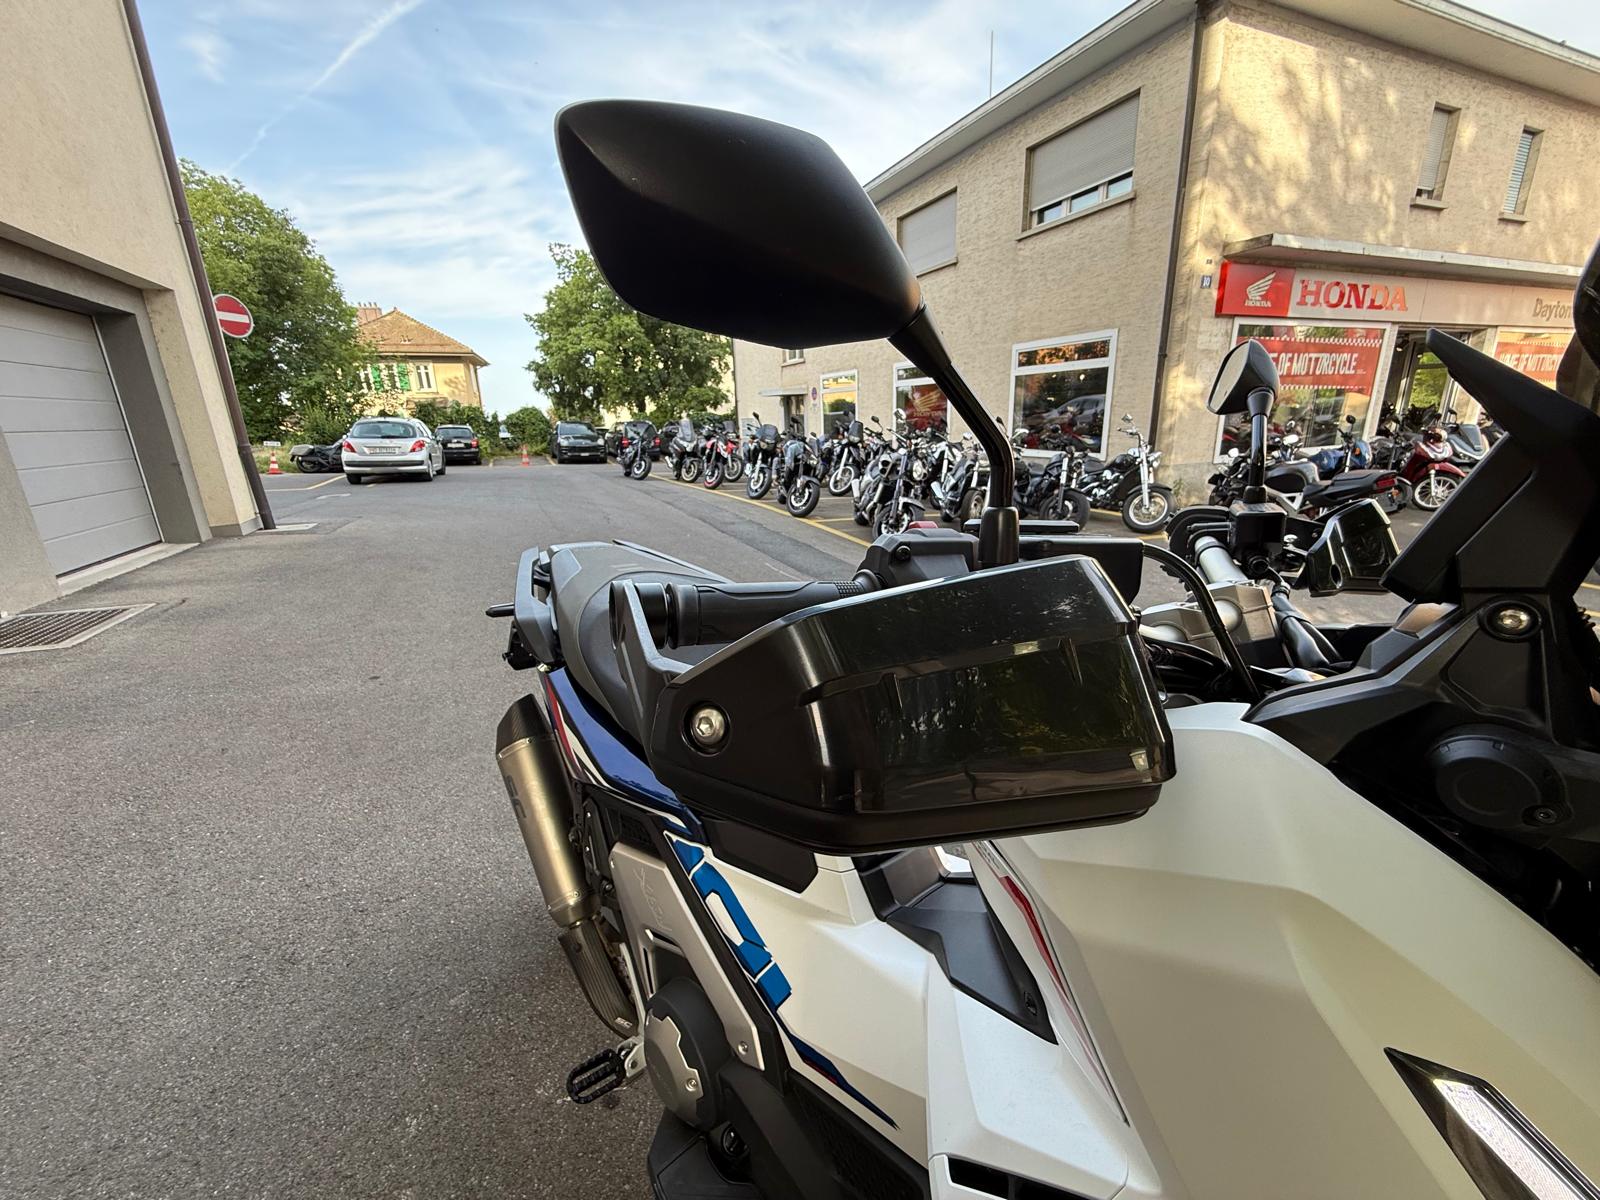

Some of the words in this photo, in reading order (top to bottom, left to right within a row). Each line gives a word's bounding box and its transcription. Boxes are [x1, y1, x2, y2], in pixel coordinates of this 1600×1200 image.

[1244, 299, 1272, 308] HONDA
[1296, 280, 1408, 311] HONDA
[1279, 352, 1293, 376] OF
